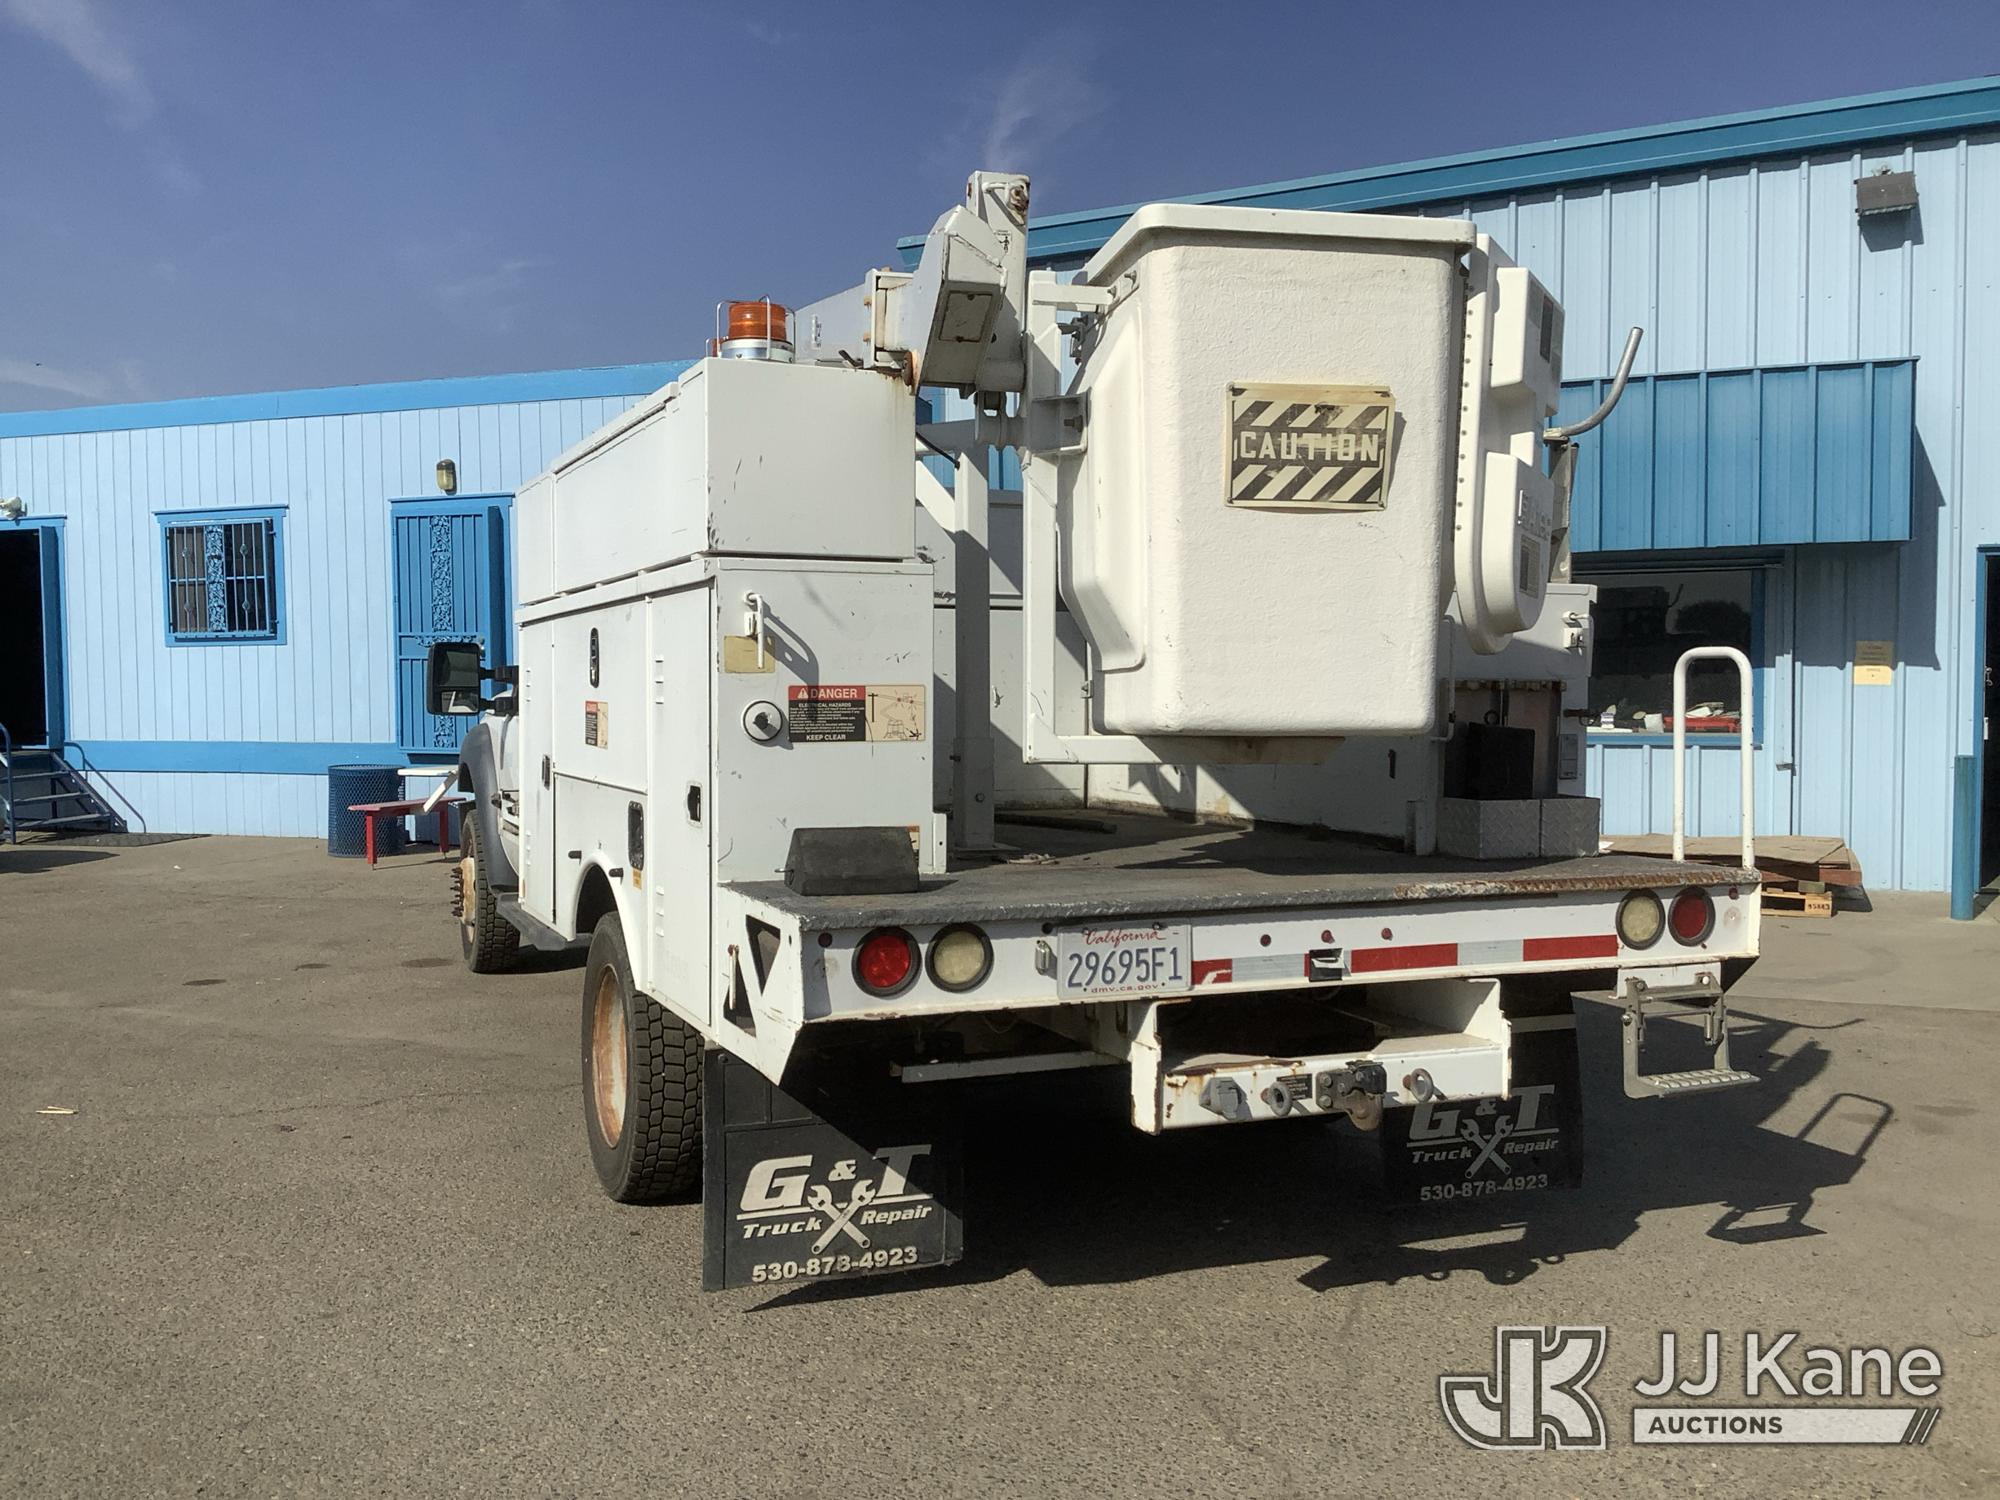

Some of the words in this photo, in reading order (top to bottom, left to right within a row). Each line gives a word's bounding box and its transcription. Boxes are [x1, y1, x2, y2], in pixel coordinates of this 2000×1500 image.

[1240, 431, 1379, 462] CAUTION
[810, 688, 858, 699] DANGER
[1085, 928, 1166, 948] California
[1067, 947, 1183, 988] 29695F1
[1091, 984, 1159, 994] dmv.ca.gov
[1411, 1146, 1473, 1164] Truck
[1503, 1139, 1559, 1155] Repair
[1420, 1174, 1549, 1201] 530-878-4923
[743, 1217, 823, 1239] Truck
[860, 1205, 933, 1225] Repair
[752, 1246, 919, 1283] 530-878-4923
